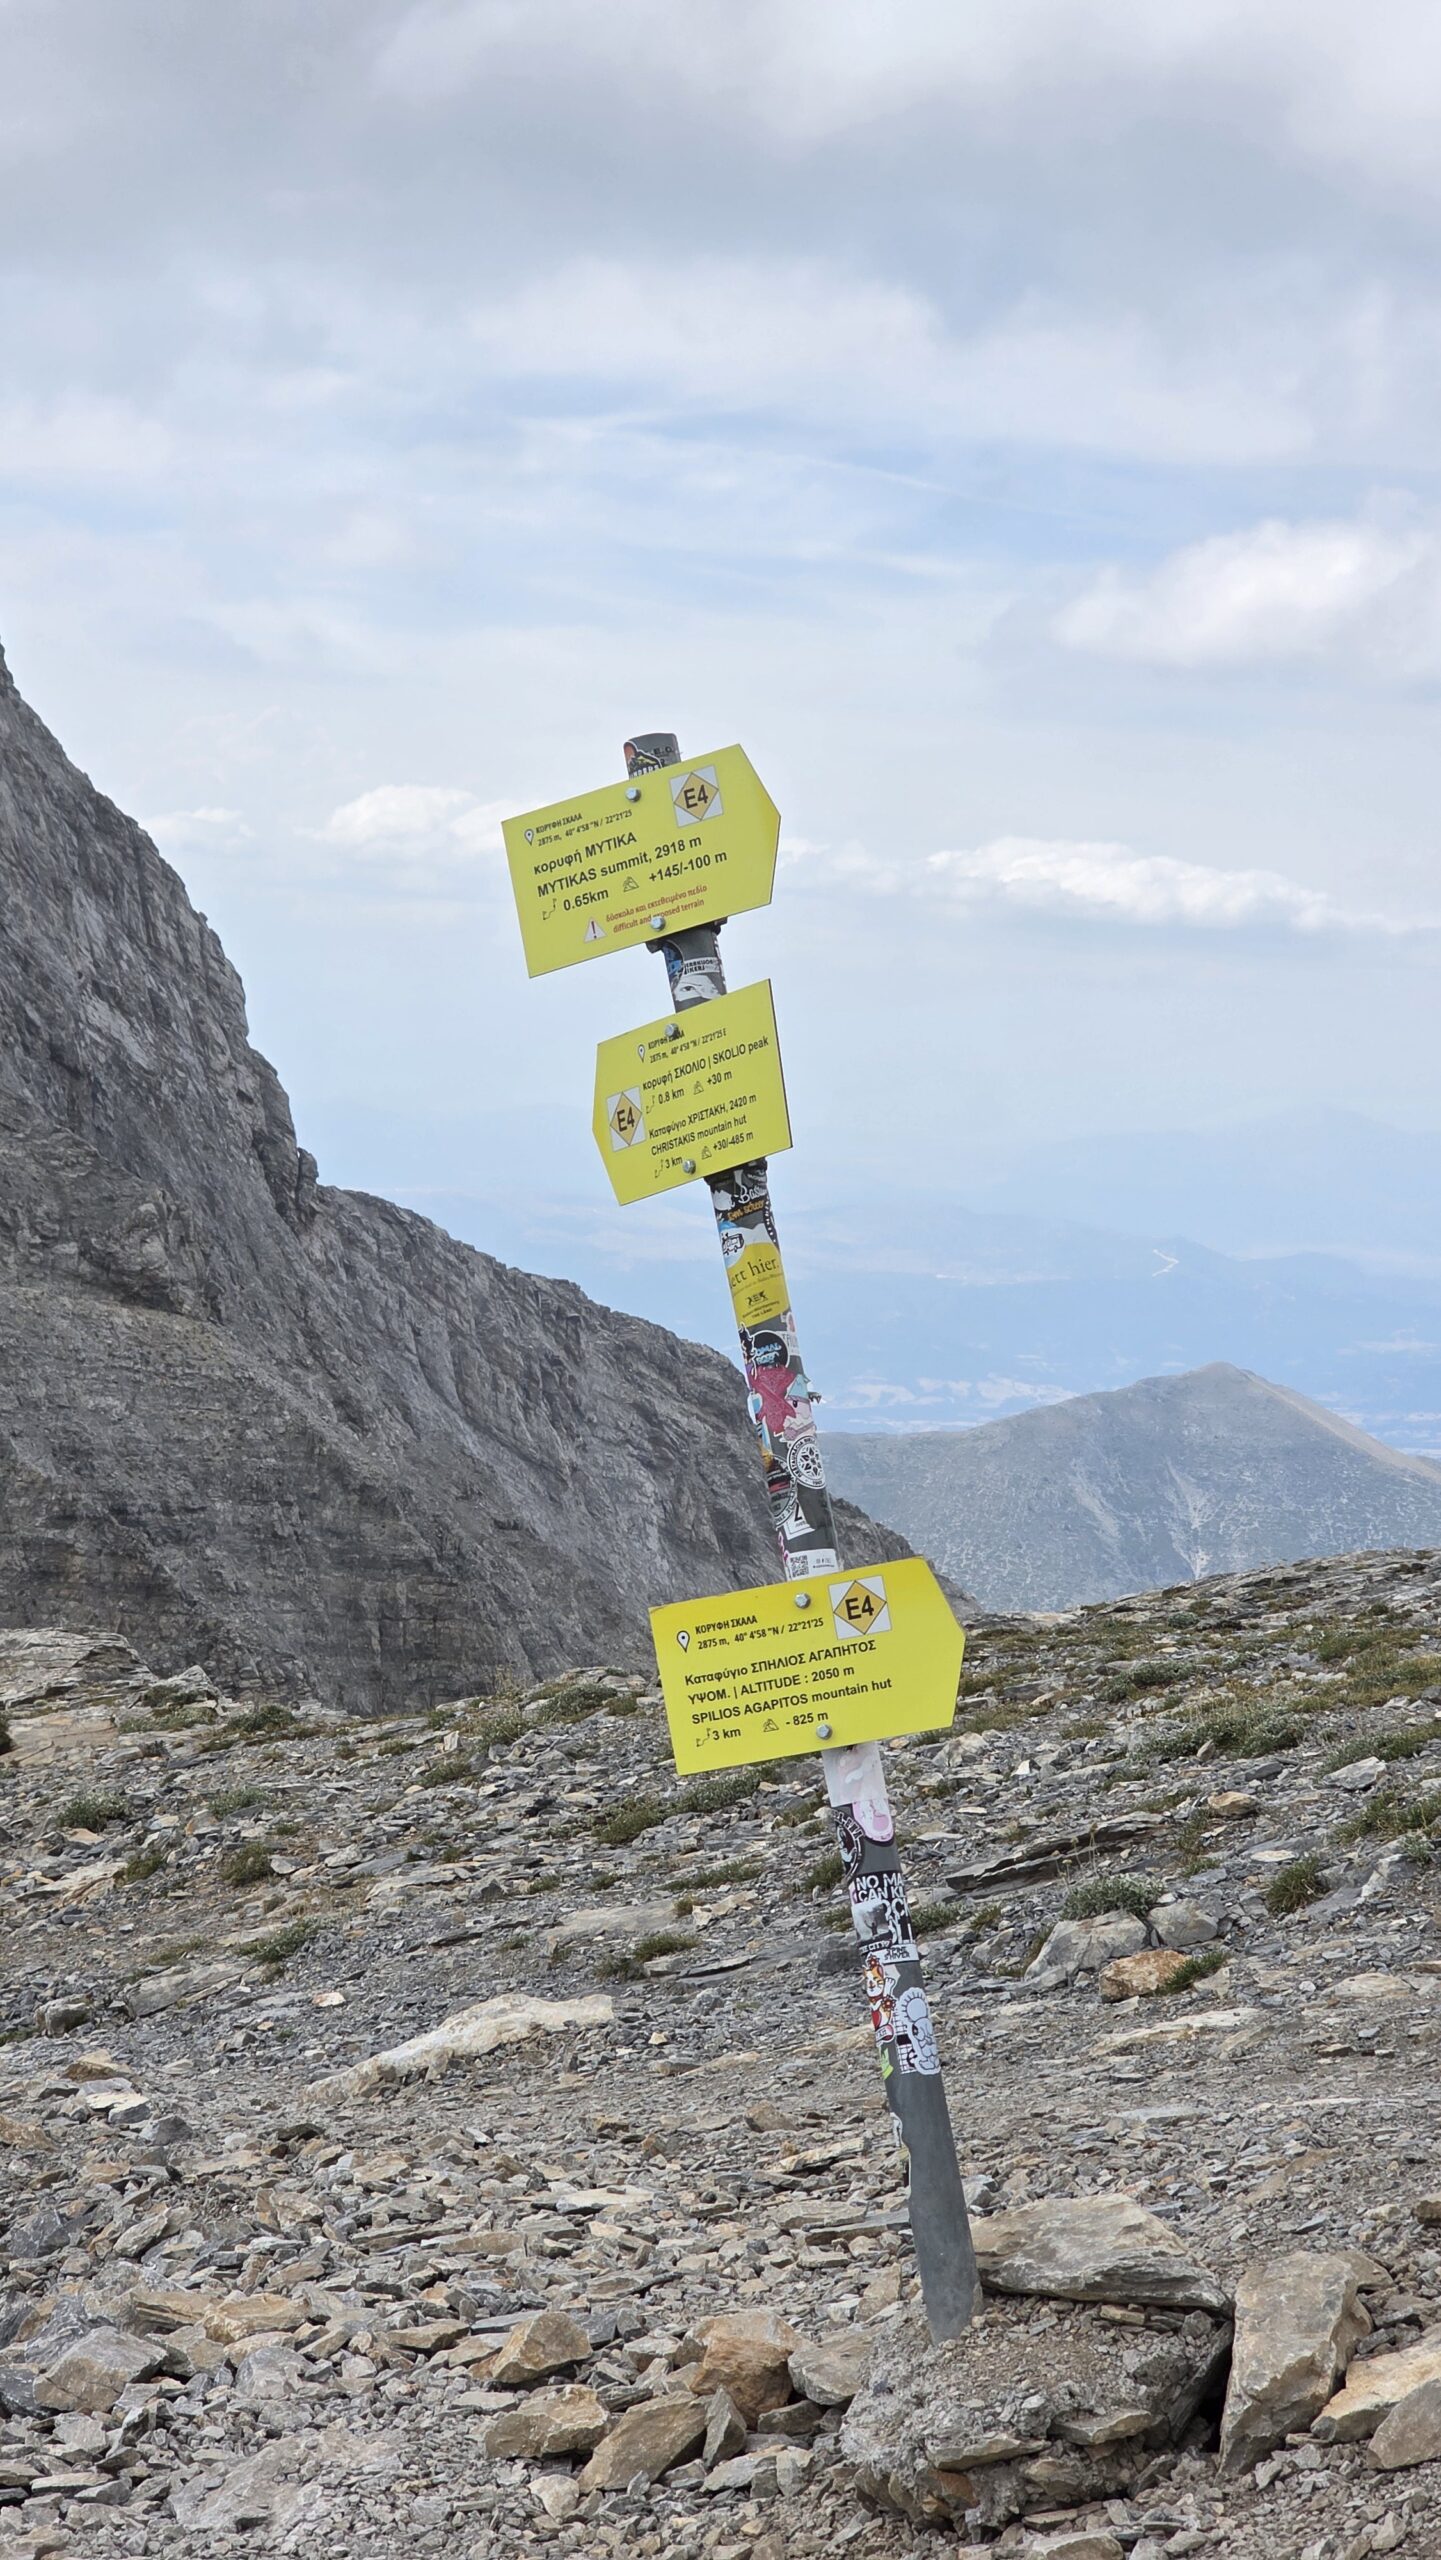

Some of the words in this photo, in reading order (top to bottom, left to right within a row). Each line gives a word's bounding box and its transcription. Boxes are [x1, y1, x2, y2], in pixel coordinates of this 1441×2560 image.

[684, 784, 708, 809] E4
[536, 819, 562, 834] ΚΟΡΥΦΗ
[562, 812, 583, 826] ΣΚΑΛΑ
[534, 849, 583, 875] κορυφή
[585, 832, 637, 858] ΜΥΤΙΚΑ
[537, 835, 553, 847] 2875
[537, 868, 597, 898] MYTIKAS
[600, 851, 652, 878] summit,
[654, 839, 685, 860] 2918
[689, 836, 702, 849] m
[563, 889, 609, 911] 0.65km
[648, 854, 711, 882] +145/-100
[714, 851, 727, 864] m
[606, 908, 634, 922] δύσκολο
[635, 904, 646, 913] και
[613, 919, 638, 933] difficult
[640, 914, 652, 925] and
[681, 899, 705, 912] terrain
[643, 1069, 674, 1092] κορυφή
[674, 1058, 707, 1079] ΣΚΟΛΙΟ
[712, 1043, 746, 1065] SKOLIO
[748, 1035, 769, 1055] peak
[658, 1090, 671, 1105] 0.8
[671, 1087, 685, 1100] km
[707, 1071, 722, 1086] +30
[724, 1070, 733, 1081] m
[617, 1106, 635, 1132] E4
[649, 1120, 687, 1140] Καταφύγιο
[687, 1103, 729, 1125] ΧΡΙΣΤΑΚΗ,
[729, 1095, 748, 1111] 2420
[749, 1093, 757, 1103] m
[651, 1131, 696, 1156] CHRISTAKIS
[697, 1119, 733, 1140] mountain
[733, 1114, 748, 1128] hut
[665, 1159, 671, 1169] 3
[671, 1155, 683, 1167] km
[713, 1133, 745, 1151] +30/-485
[746, 1131, 754, 1141] m
[845, 1594, 875, 1621] E4
[695, 1621, 730, 1635] ΚΟΡΥΦΗ
[731, 1615, 758, 1629] ΣΚΑΛΑ
[698, 1638, 718, 1650] 2875
[719, 1636, 730, 1646] m,
[685, 1666, 748, 1686] Καταφύγιο
[750, 1653, 806, 1674] ΣΠΗΛΙΟΣ
[808, 1639, 877, 1663] ΑΓΑΠΗΤΟΣ
[688, 1688, 731, 1705] ΥΨΟΜ.
[740, 1674, 801, 1696] ALTITUDE
[811, 1667, 840, 1683] 2050
[843, 1666, 855, 1676] m
[691, 1706, 741, 1725] SPILIOS
[743, 1693, 809, 1715] AGAPITOS
[811, 1683, 869, 1703] mountain
[871, 1678, 892, 1691] hut
[712, 1729, 720, 1741] 3
[722, 1728, 741, 1739] km
[792, 1712, 814, 1726] 825
[817, 1711, 829, 1721] m
[856, 1874, 880, 1891] NO
